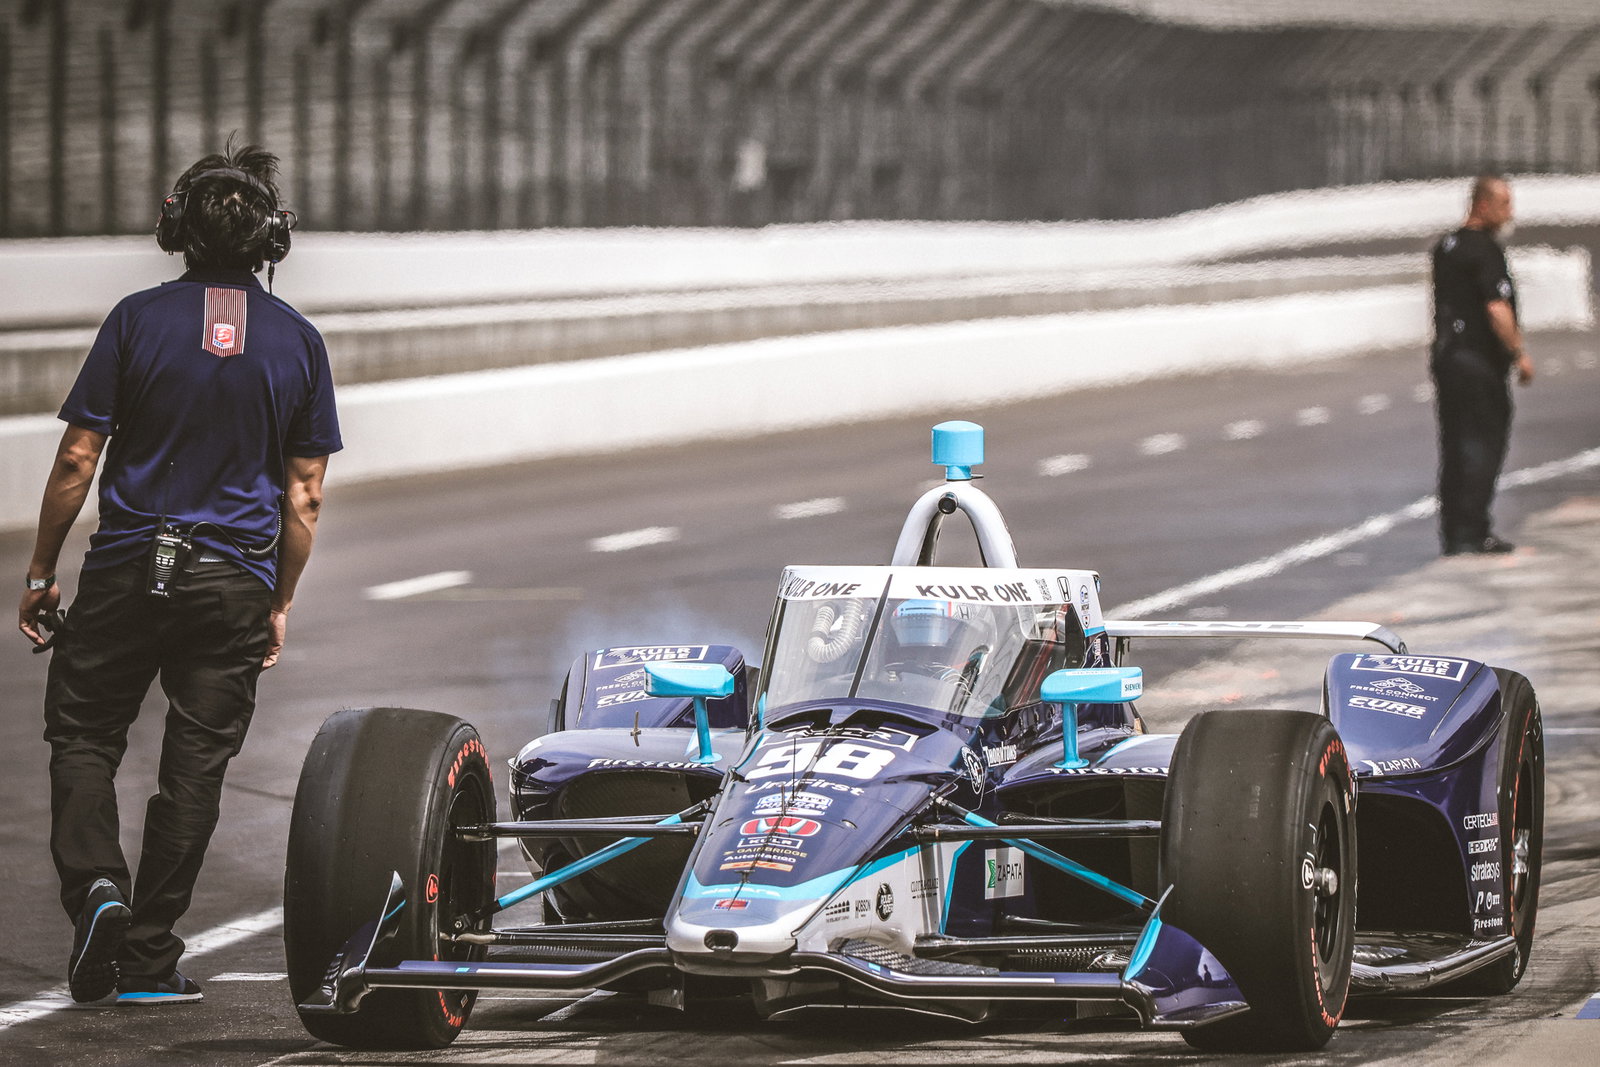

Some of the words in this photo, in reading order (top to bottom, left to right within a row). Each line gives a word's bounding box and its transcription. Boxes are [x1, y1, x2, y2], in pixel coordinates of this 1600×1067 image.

[812, 583, 862, 597] ONE
[915, 585, 993, 602] KULR
[993, 582, 1032, 602] ONE
[632, 647, 691, 656] KULR
[1391, 657, 1450, 669] KULR
[1398, 664, 1448, 675] VIBE
[597, 690, 652, 705] CUR
[1349, 684, 1385, 694] FRESH
[1386, 688, 1440, 702] CONNECT
[1348, 696, 1427, 716] CURB
[745, 742, 896, 780] 98
[1378, 757, 1421, 772] ZAPATA
[744, 778, 865, 796] UniFirst
[1464, 813, 1492, 830] CERTECH
[997, 863, 1023, 881] ZAPATA
[1471, 861, 1501, 882] stratasys
[1473, 917, 1504, 932] Firestone
